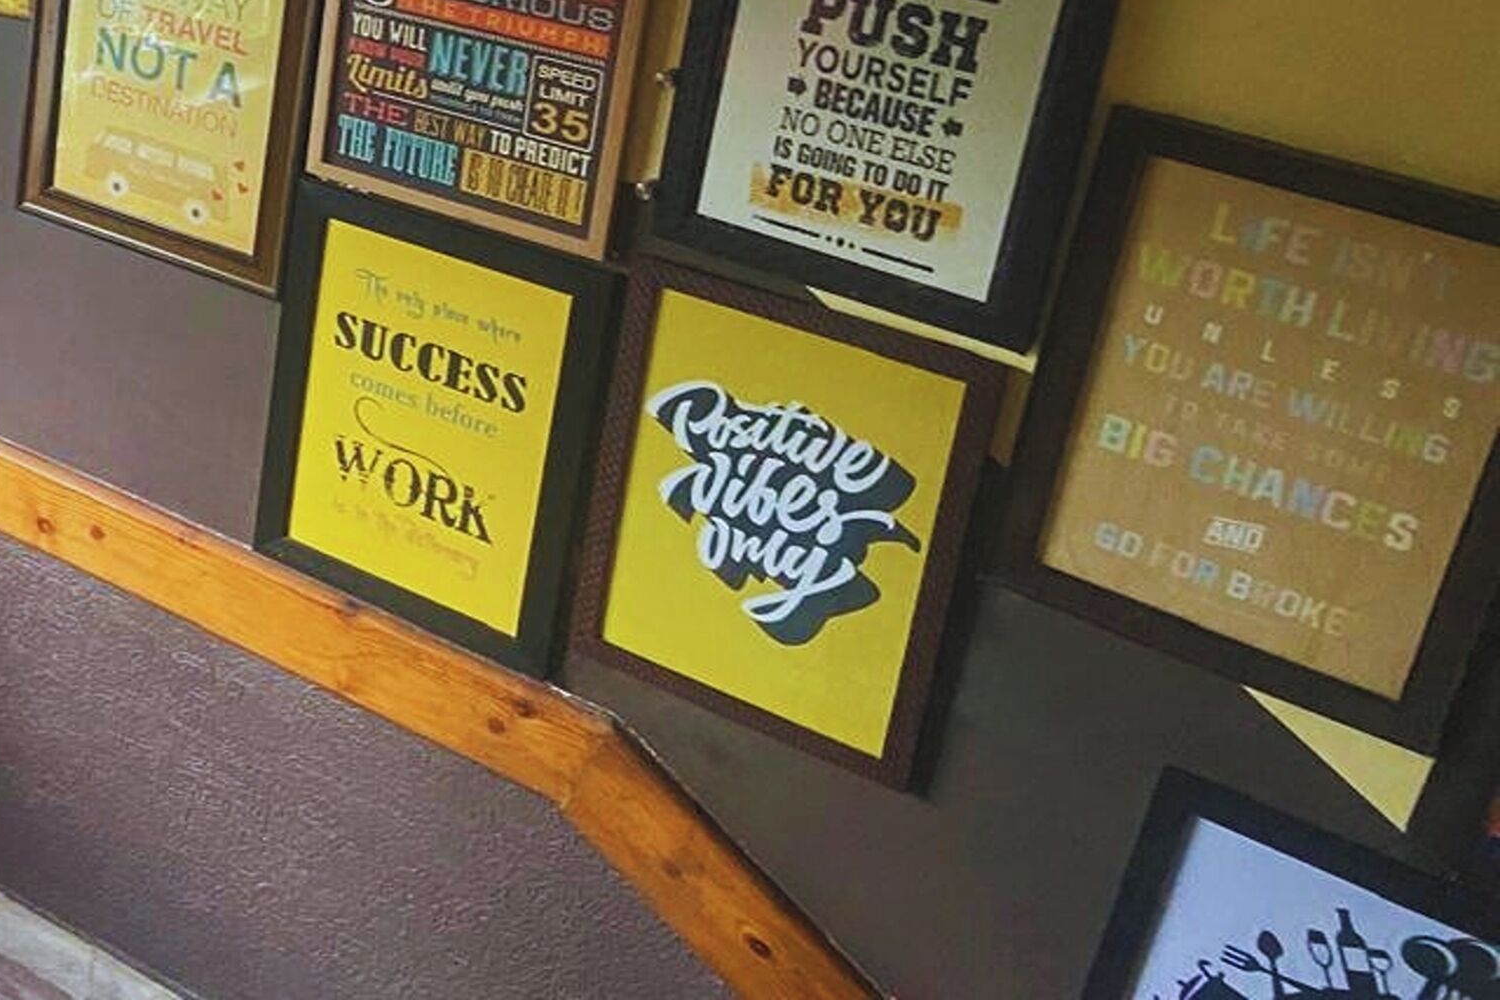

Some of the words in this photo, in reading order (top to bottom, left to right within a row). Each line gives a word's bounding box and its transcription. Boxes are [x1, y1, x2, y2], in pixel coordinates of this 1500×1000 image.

[143, 5, 249, 57] TRAVEL
[350, 11, 385, 41] YOU
[389, 20, 428, 51] WILL
[429, 31, 530, 97] NEVER
[466, 9, 609, 54] TRIUMPH
[97, 26, 198, 90] NOT
[206, 60, 242, 109] A
[346, 53, 429, 100] Limits
[537, 63, 597, 92] SPEED
[538, 83, 592, 107] LIMIT
[798, 38, 974, 107] YOURSELF
[90, 75, 237, 138] DESTINATION
[342, 91, 409, 127] THE
[412, 110, 449, 140] BEST
[453, 119, 487, 149] WAY
[489, 130, 512, 154] TO
[514, 136, 593, 177] PREDICT
[531, 102, 591, 144] 35
[779, 106, 821, 137] NO
[827, 119, 886, 156] ONE
[890, 136, 957, 176] ELSE
[813, 77, 937, 138] BECAUSE
[337, 113, 377, 163] THE
[381, 124, 460, 188] FUTURE
[772, 135, 794, 159] IS
[797, 143, 858, 179] GOING
[862, 159, 889, 186] TO
[892, 169, 922, 197] DO
[926, 179, 950, 203] IT
[765, 163, 843, 216] FOR
[858, 188, 942, 243] YOU
[1139, 242, 1319, 327] WORTH
[1326, 298, 1500, 384] LIING
[334, 311, 528, 414] SUCCESS
[350, 371, 418, 408] comes
[425, 393, 500, 438] before
[1123, 333, 1195, 381] YOU
[1201, 361, 1278, 409] ARE
[1288, 386, 1451, 465] WILLING
[646, 378, 890, 493] Positive
[334, 434, 496, 547] WORK
[658, 451, 895, 545] Vibes
[1097, 413, 1179, 469] BIG
[1189, 443, 1420, 553] CHANCES
[1203, 515, 1267, 555] AND
[1093, 521, 1144, 560] GO
[1150, 541, 1220, 590] FOR
[1225, 568, 1350, 638] BROKE
